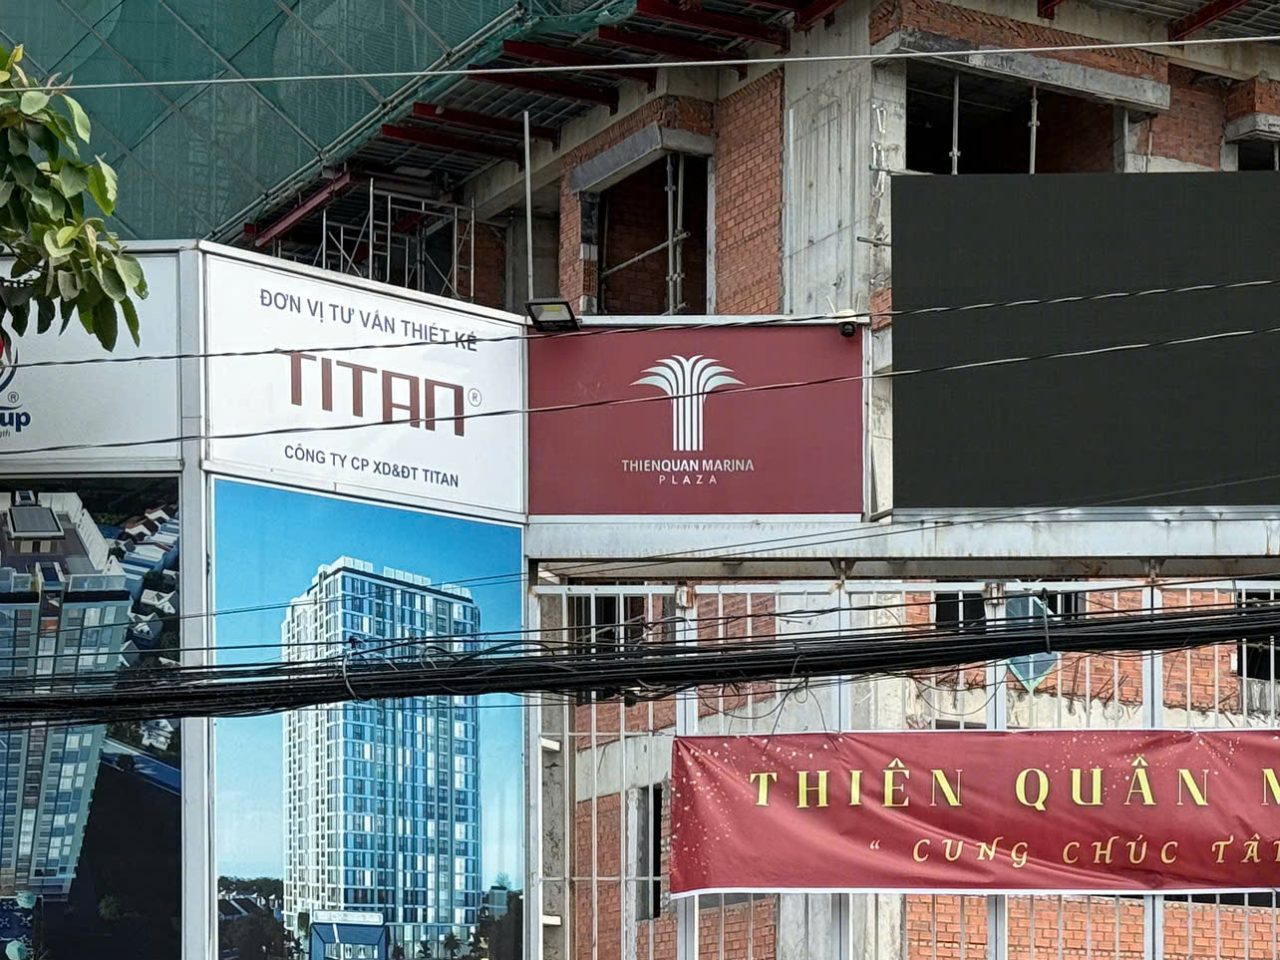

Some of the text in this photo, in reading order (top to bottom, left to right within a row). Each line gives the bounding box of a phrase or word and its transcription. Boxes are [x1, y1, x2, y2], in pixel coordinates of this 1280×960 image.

[260, 288, 301, 314] ĐƠN
[307, 298, 324, 323] VỊ
[329, 304, 355, 324] TƯ
[275, 348, 464, 437] TITAN
[284, 443, 459, 488] CÔNG TY CP XD&ĐT TITAN
[622, 460, 754, 472] THIENQUAN MARINA
[659, 474, 718, 485] PLAZA
[750, 758, 963, 808] THIÊN
[1015, 756, 1209, 811] QUÂN
[912, 837, 1029, 868] CUNG
[1062, 834, 1179, 864] CHÚC
